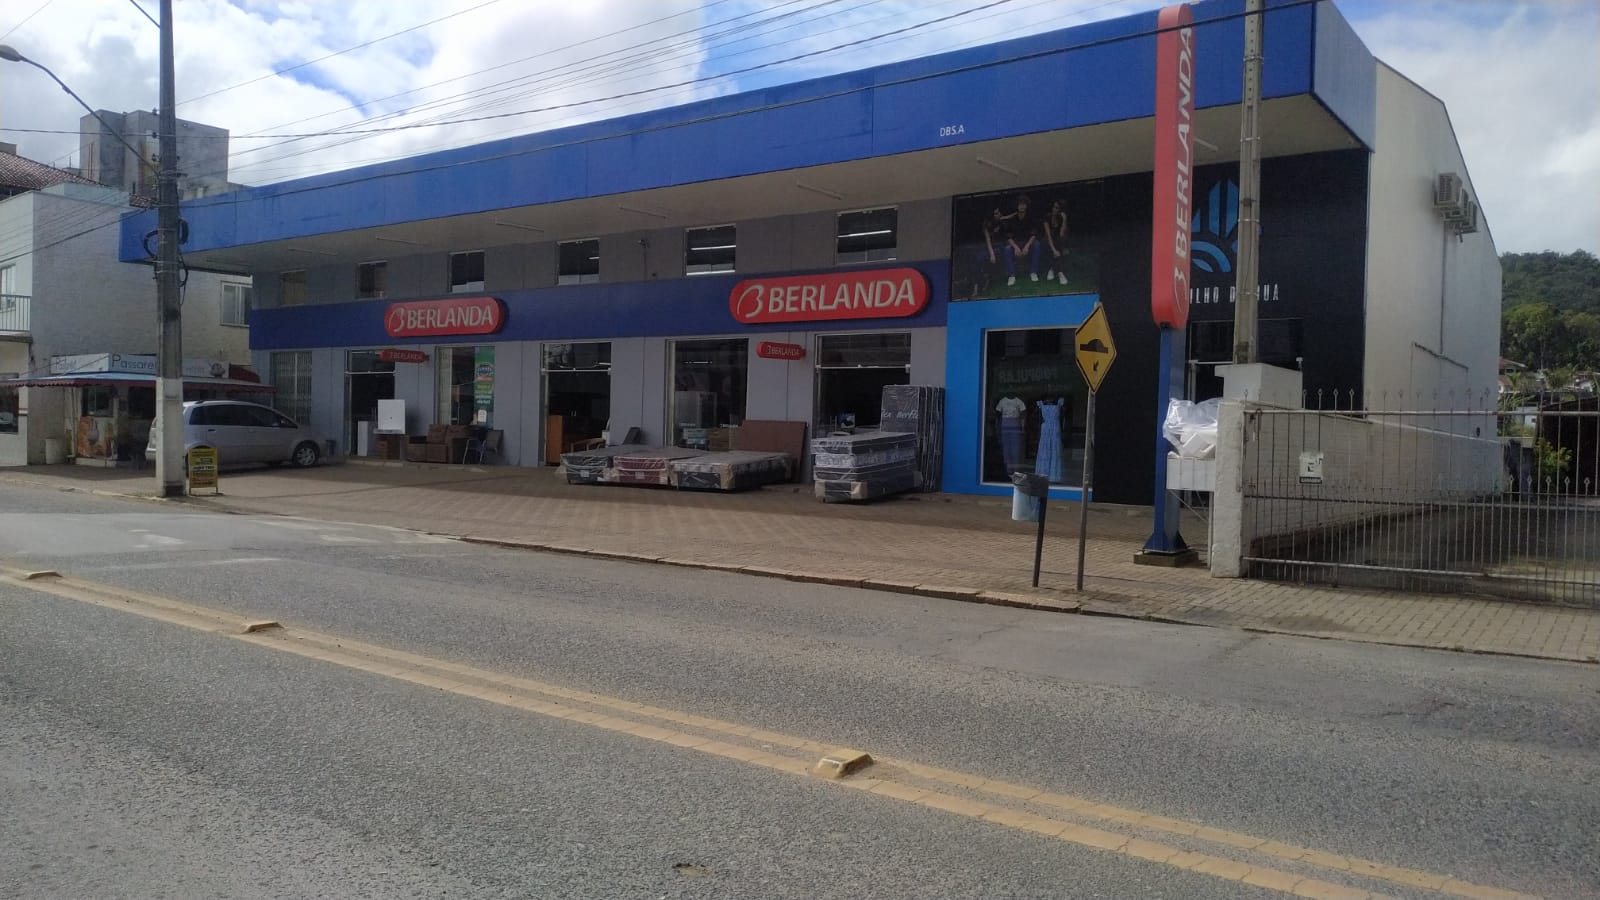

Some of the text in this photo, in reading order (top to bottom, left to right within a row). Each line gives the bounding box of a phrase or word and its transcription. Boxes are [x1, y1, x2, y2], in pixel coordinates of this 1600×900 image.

[1175, 26, 1193, 259] BERLANDA
[768, 278, 916, 313] BERLANDA
[406, 305, 494, 329] BERLANDA
[771, 346, 800, 356] BERLANDA
